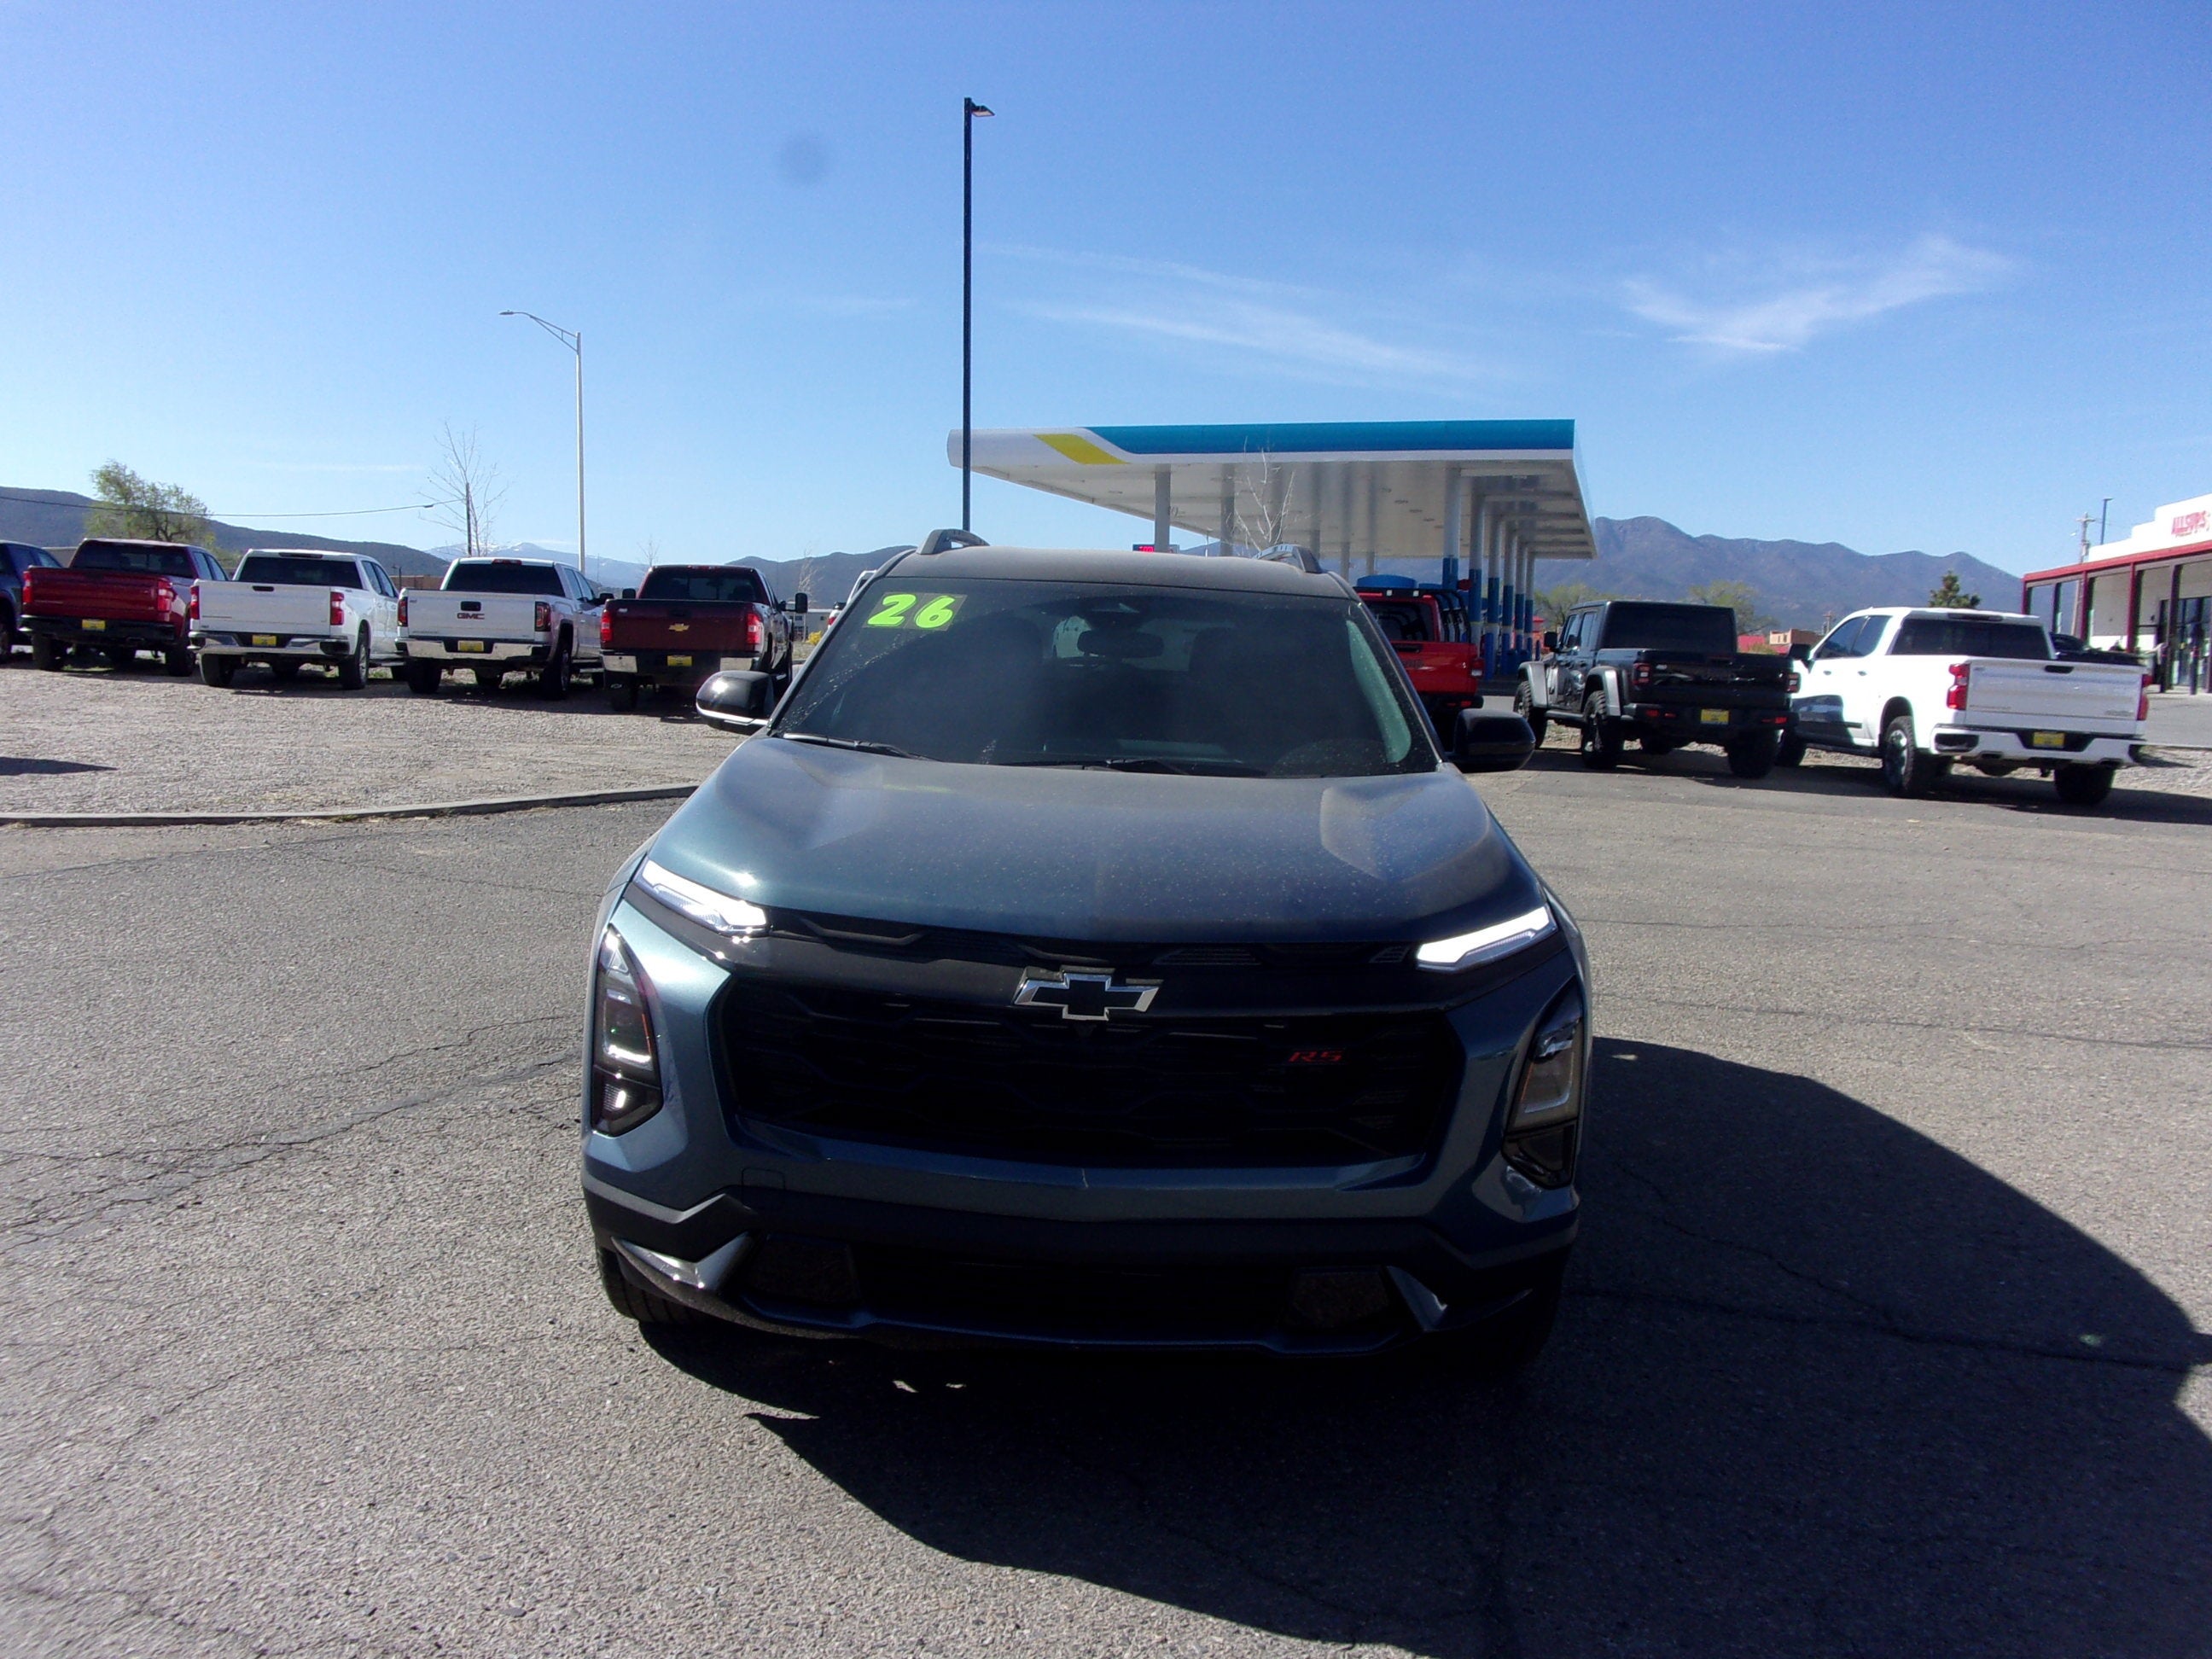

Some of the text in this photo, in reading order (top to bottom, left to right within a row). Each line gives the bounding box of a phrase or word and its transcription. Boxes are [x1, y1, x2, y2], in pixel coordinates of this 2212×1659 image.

[457, 612, 486, 620] GMC
[867, 593, 956, 628] 26
[1287, 1050, 1344, 1063] RS
